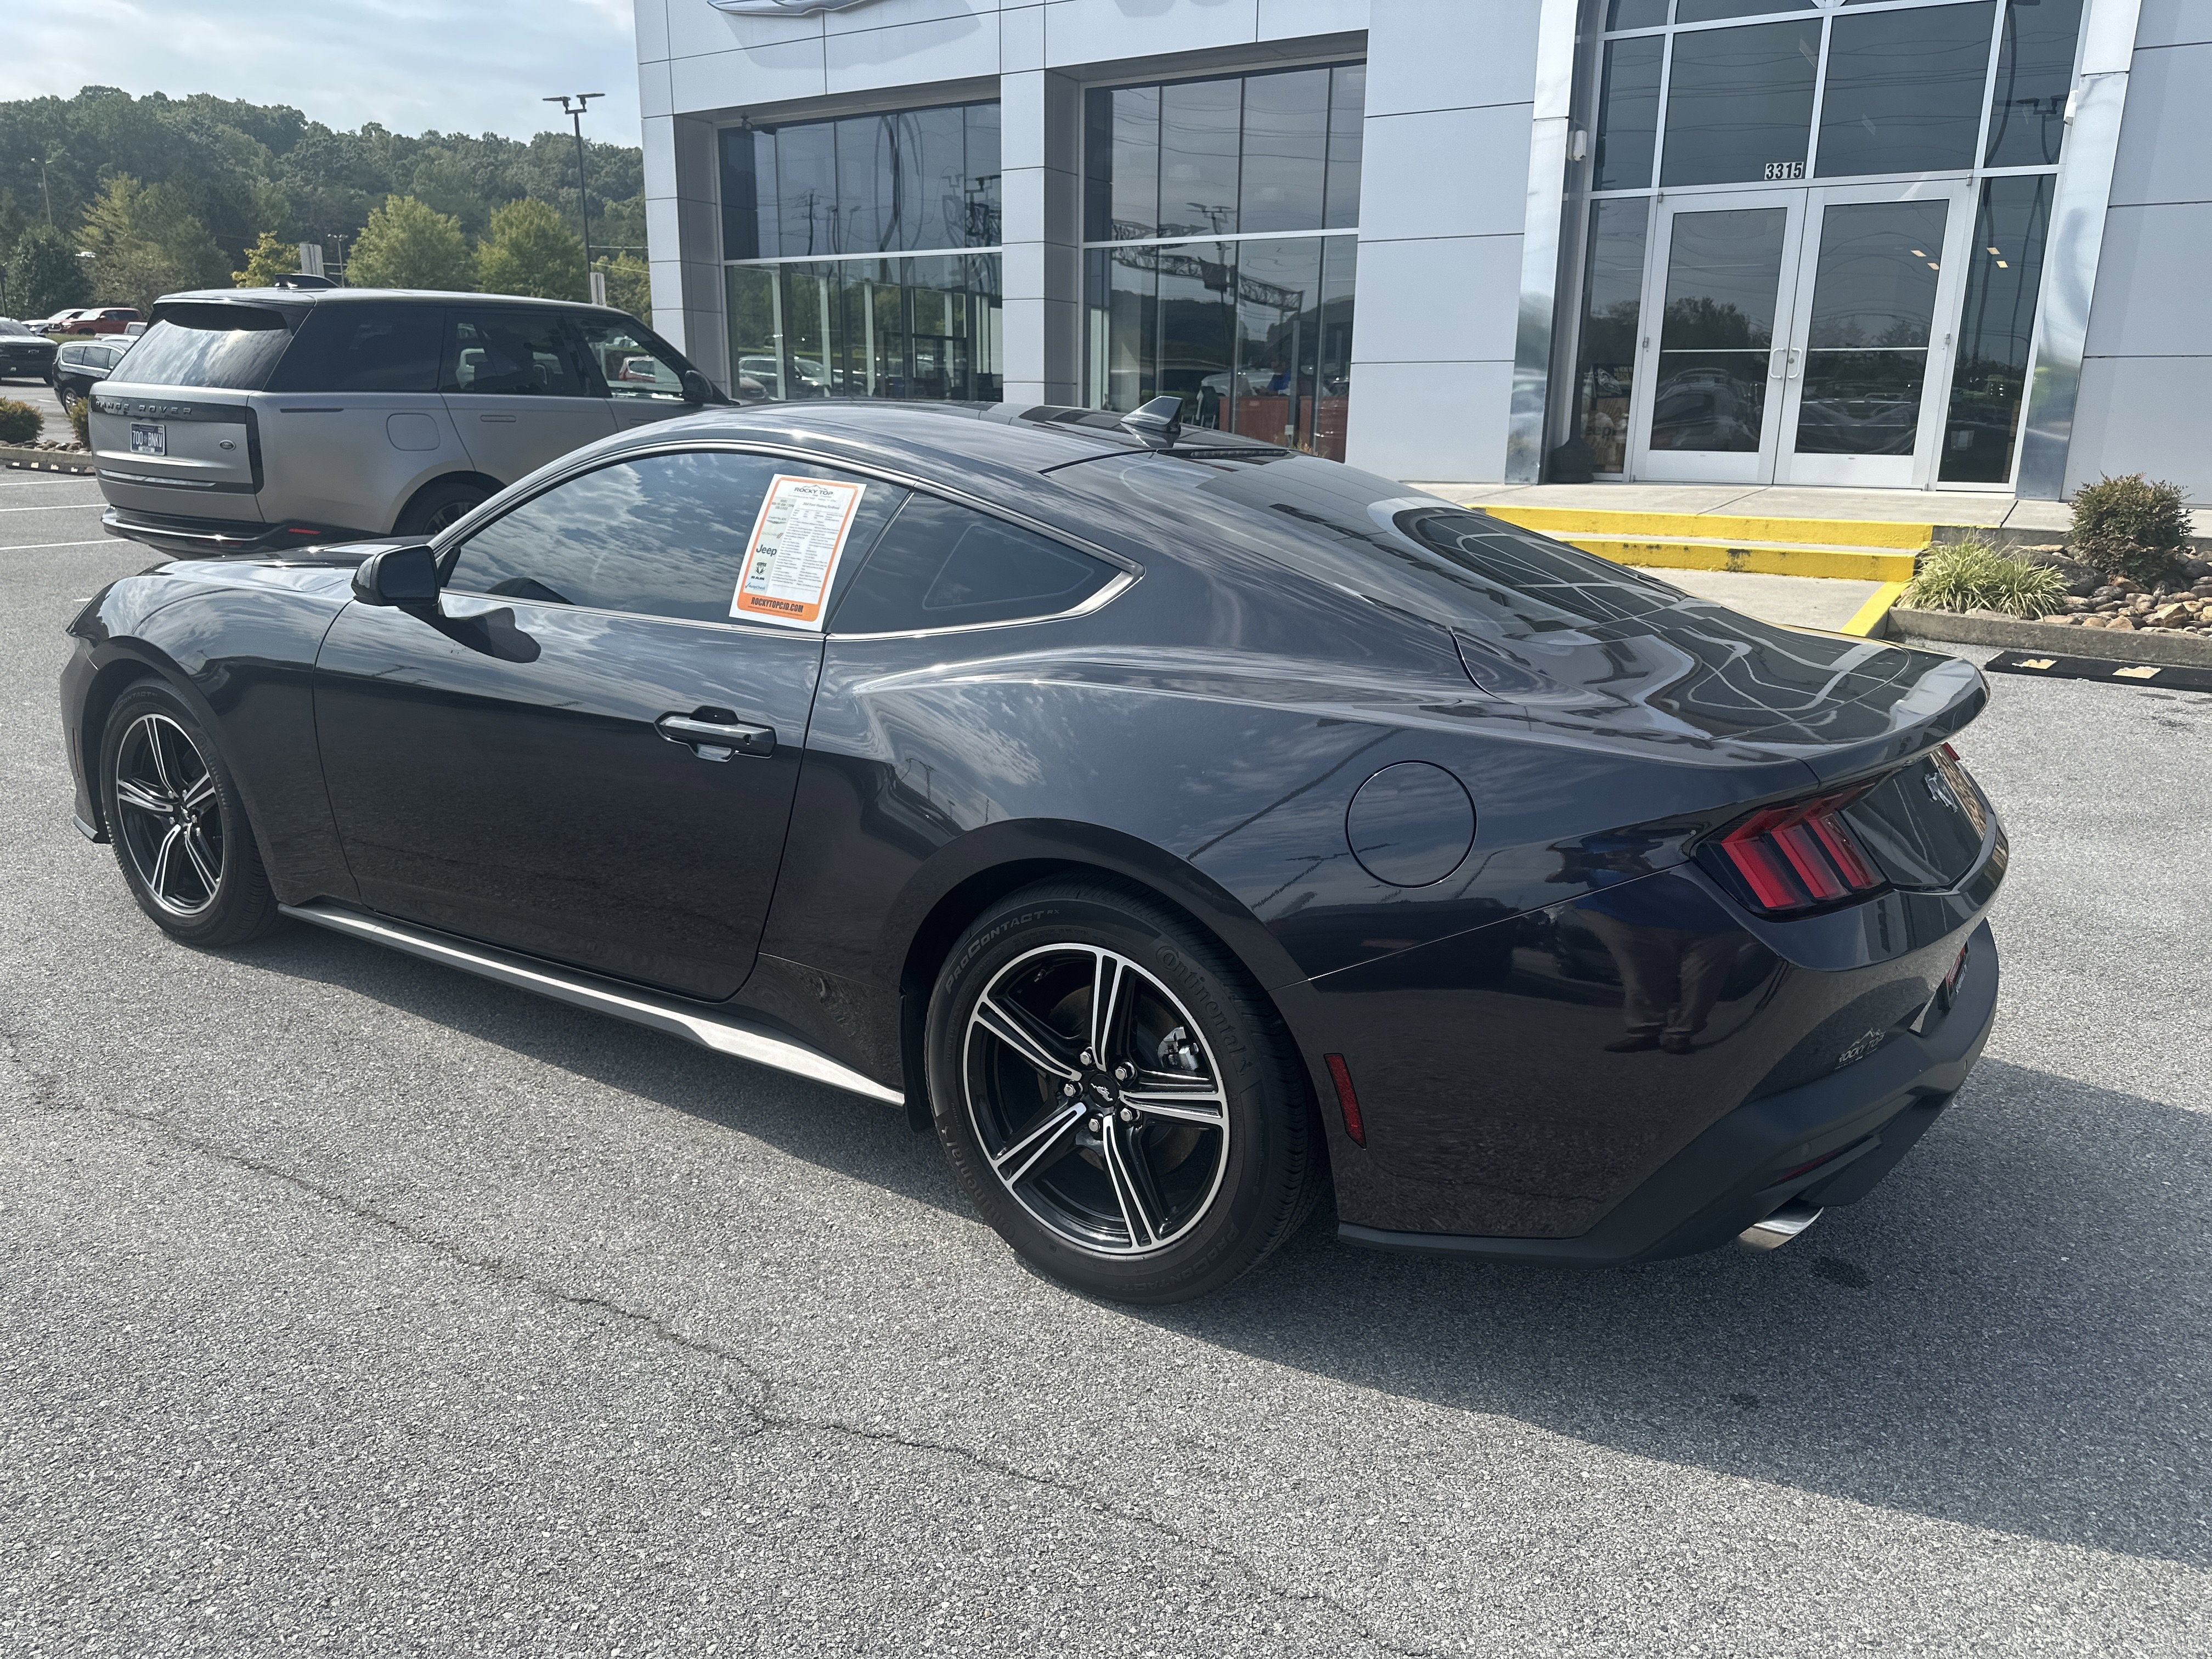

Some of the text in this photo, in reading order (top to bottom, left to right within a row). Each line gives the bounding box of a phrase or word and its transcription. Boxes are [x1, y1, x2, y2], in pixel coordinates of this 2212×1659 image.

[1766, 162, 1802, 179] 3315
[96, 400, 191, 414] RANGE ROVER
[132, 431, 143, 445] 700
[756, 544, 777, 557] Jeep
[751, 597, 804, 613] ROCKYTOPCJD.COM
